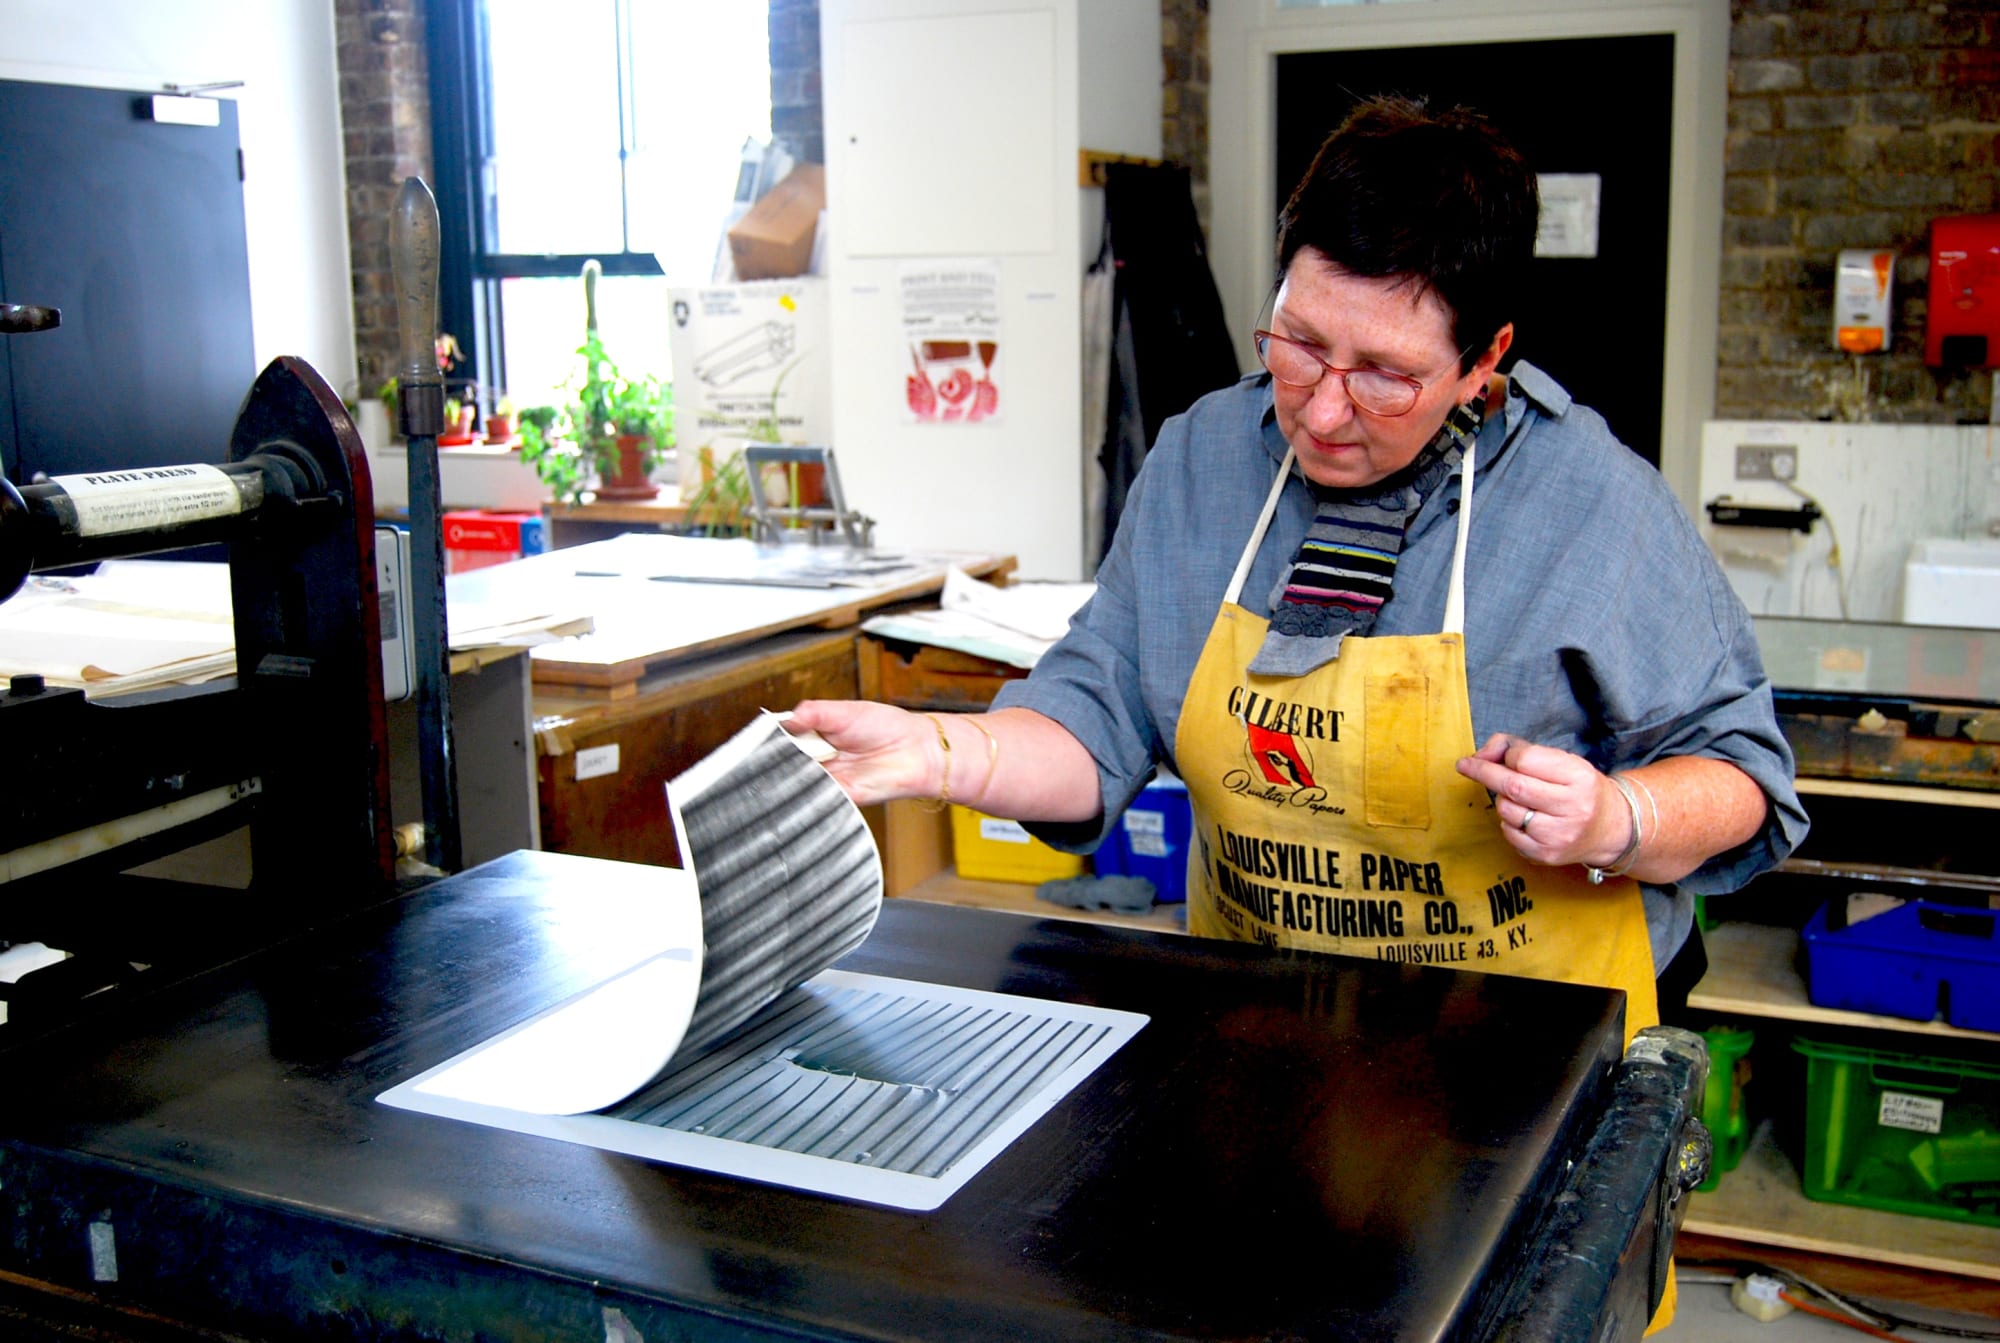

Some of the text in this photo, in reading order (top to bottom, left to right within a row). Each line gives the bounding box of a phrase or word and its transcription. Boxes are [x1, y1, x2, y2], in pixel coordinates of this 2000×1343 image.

[84, 467, 198, 486] PLATE PRESS
[1228, 685, 1345, 743] GILBERT
[1222, 769, 1346, 815] Quality Papers
[1217, 823, 1342, 889] LOUISVILLE
[1360, 852, 1445, 896] PAPER
[1216, 858, 1404, 938] MANUFACTURING
[1424, 900, 1474, 937] CO.,
[1486, 875, 1533, 928] INC.
[1377, 941, 1467, 964] LOUISVILLE
[1507, 922, 1533, 951] KY.
